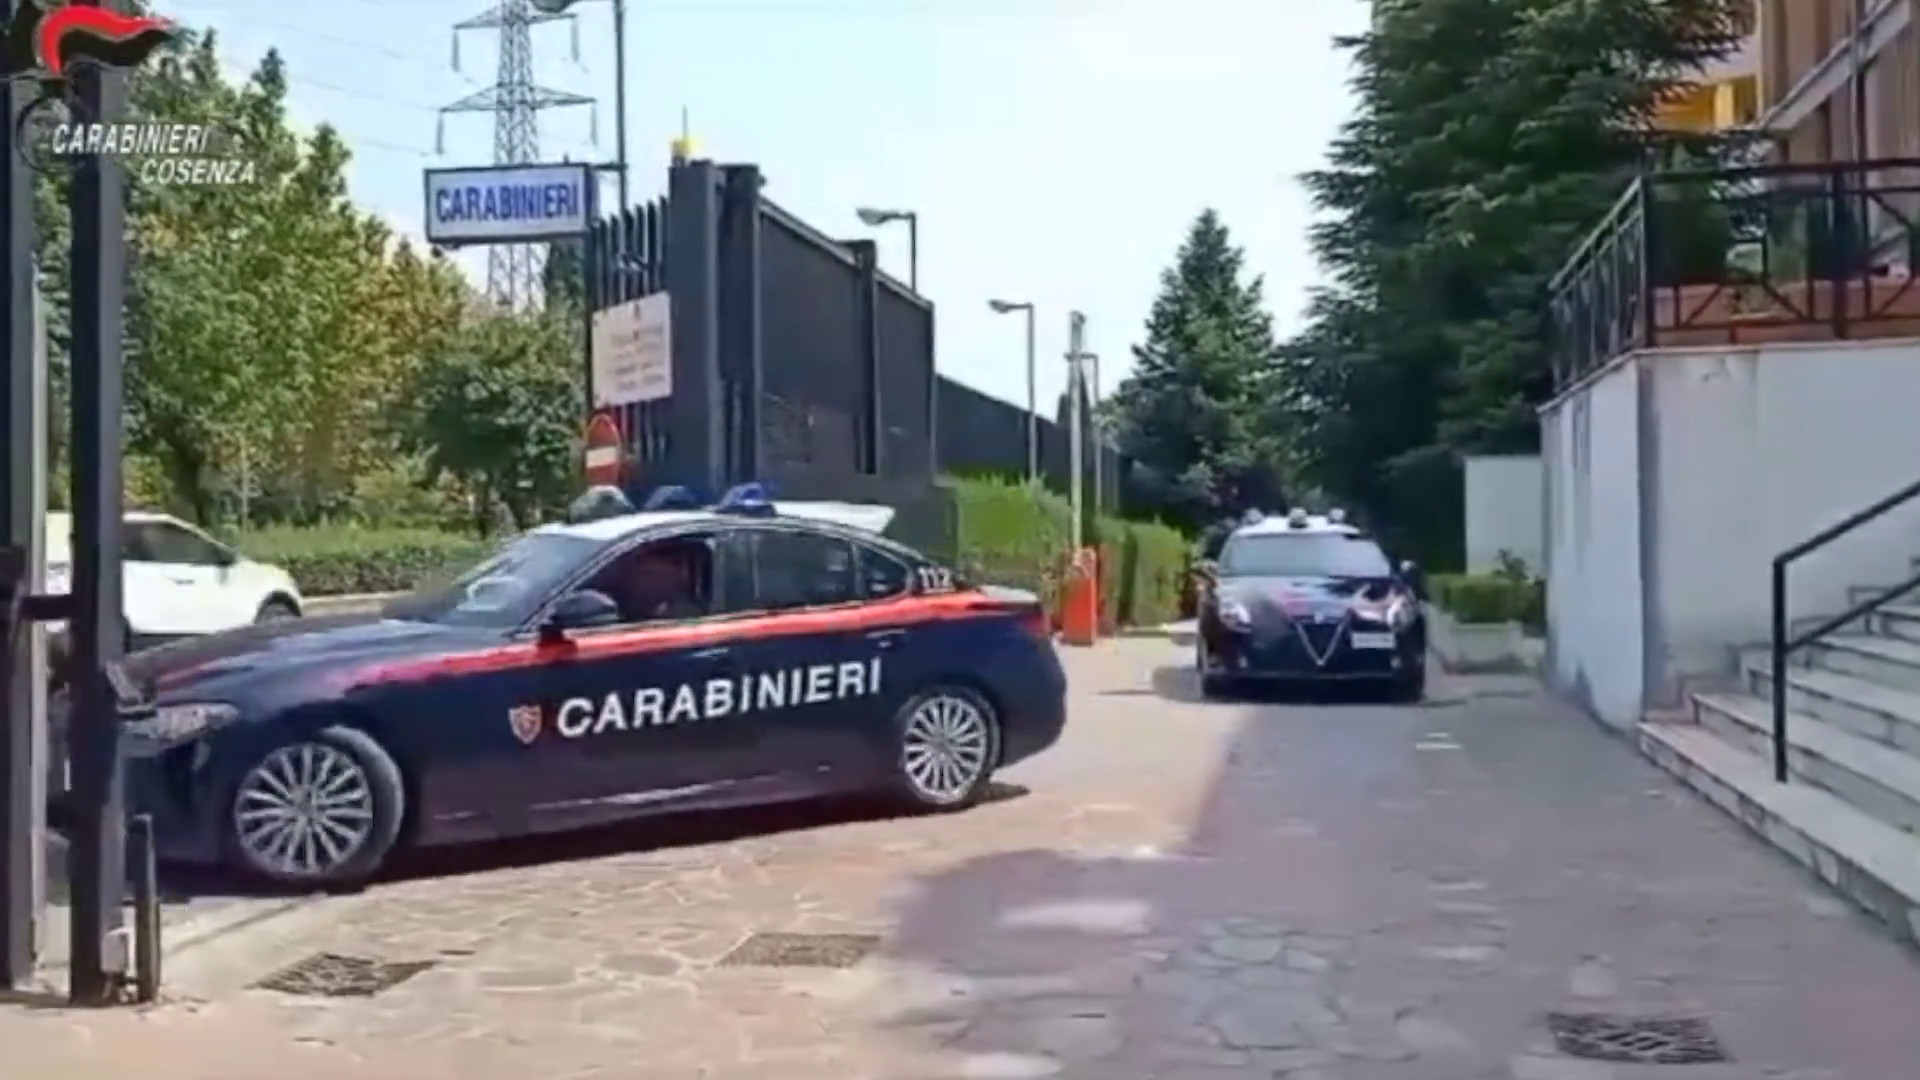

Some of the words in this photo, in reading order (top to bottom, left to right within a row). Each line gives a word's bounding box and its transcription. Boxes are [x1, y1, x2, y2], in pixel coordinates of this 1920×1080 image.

[435, 183, 579, 223] CARABINIERI
[918, 567, 955, 592] 112
[556, 658, 883, 737] CARABINIERI
